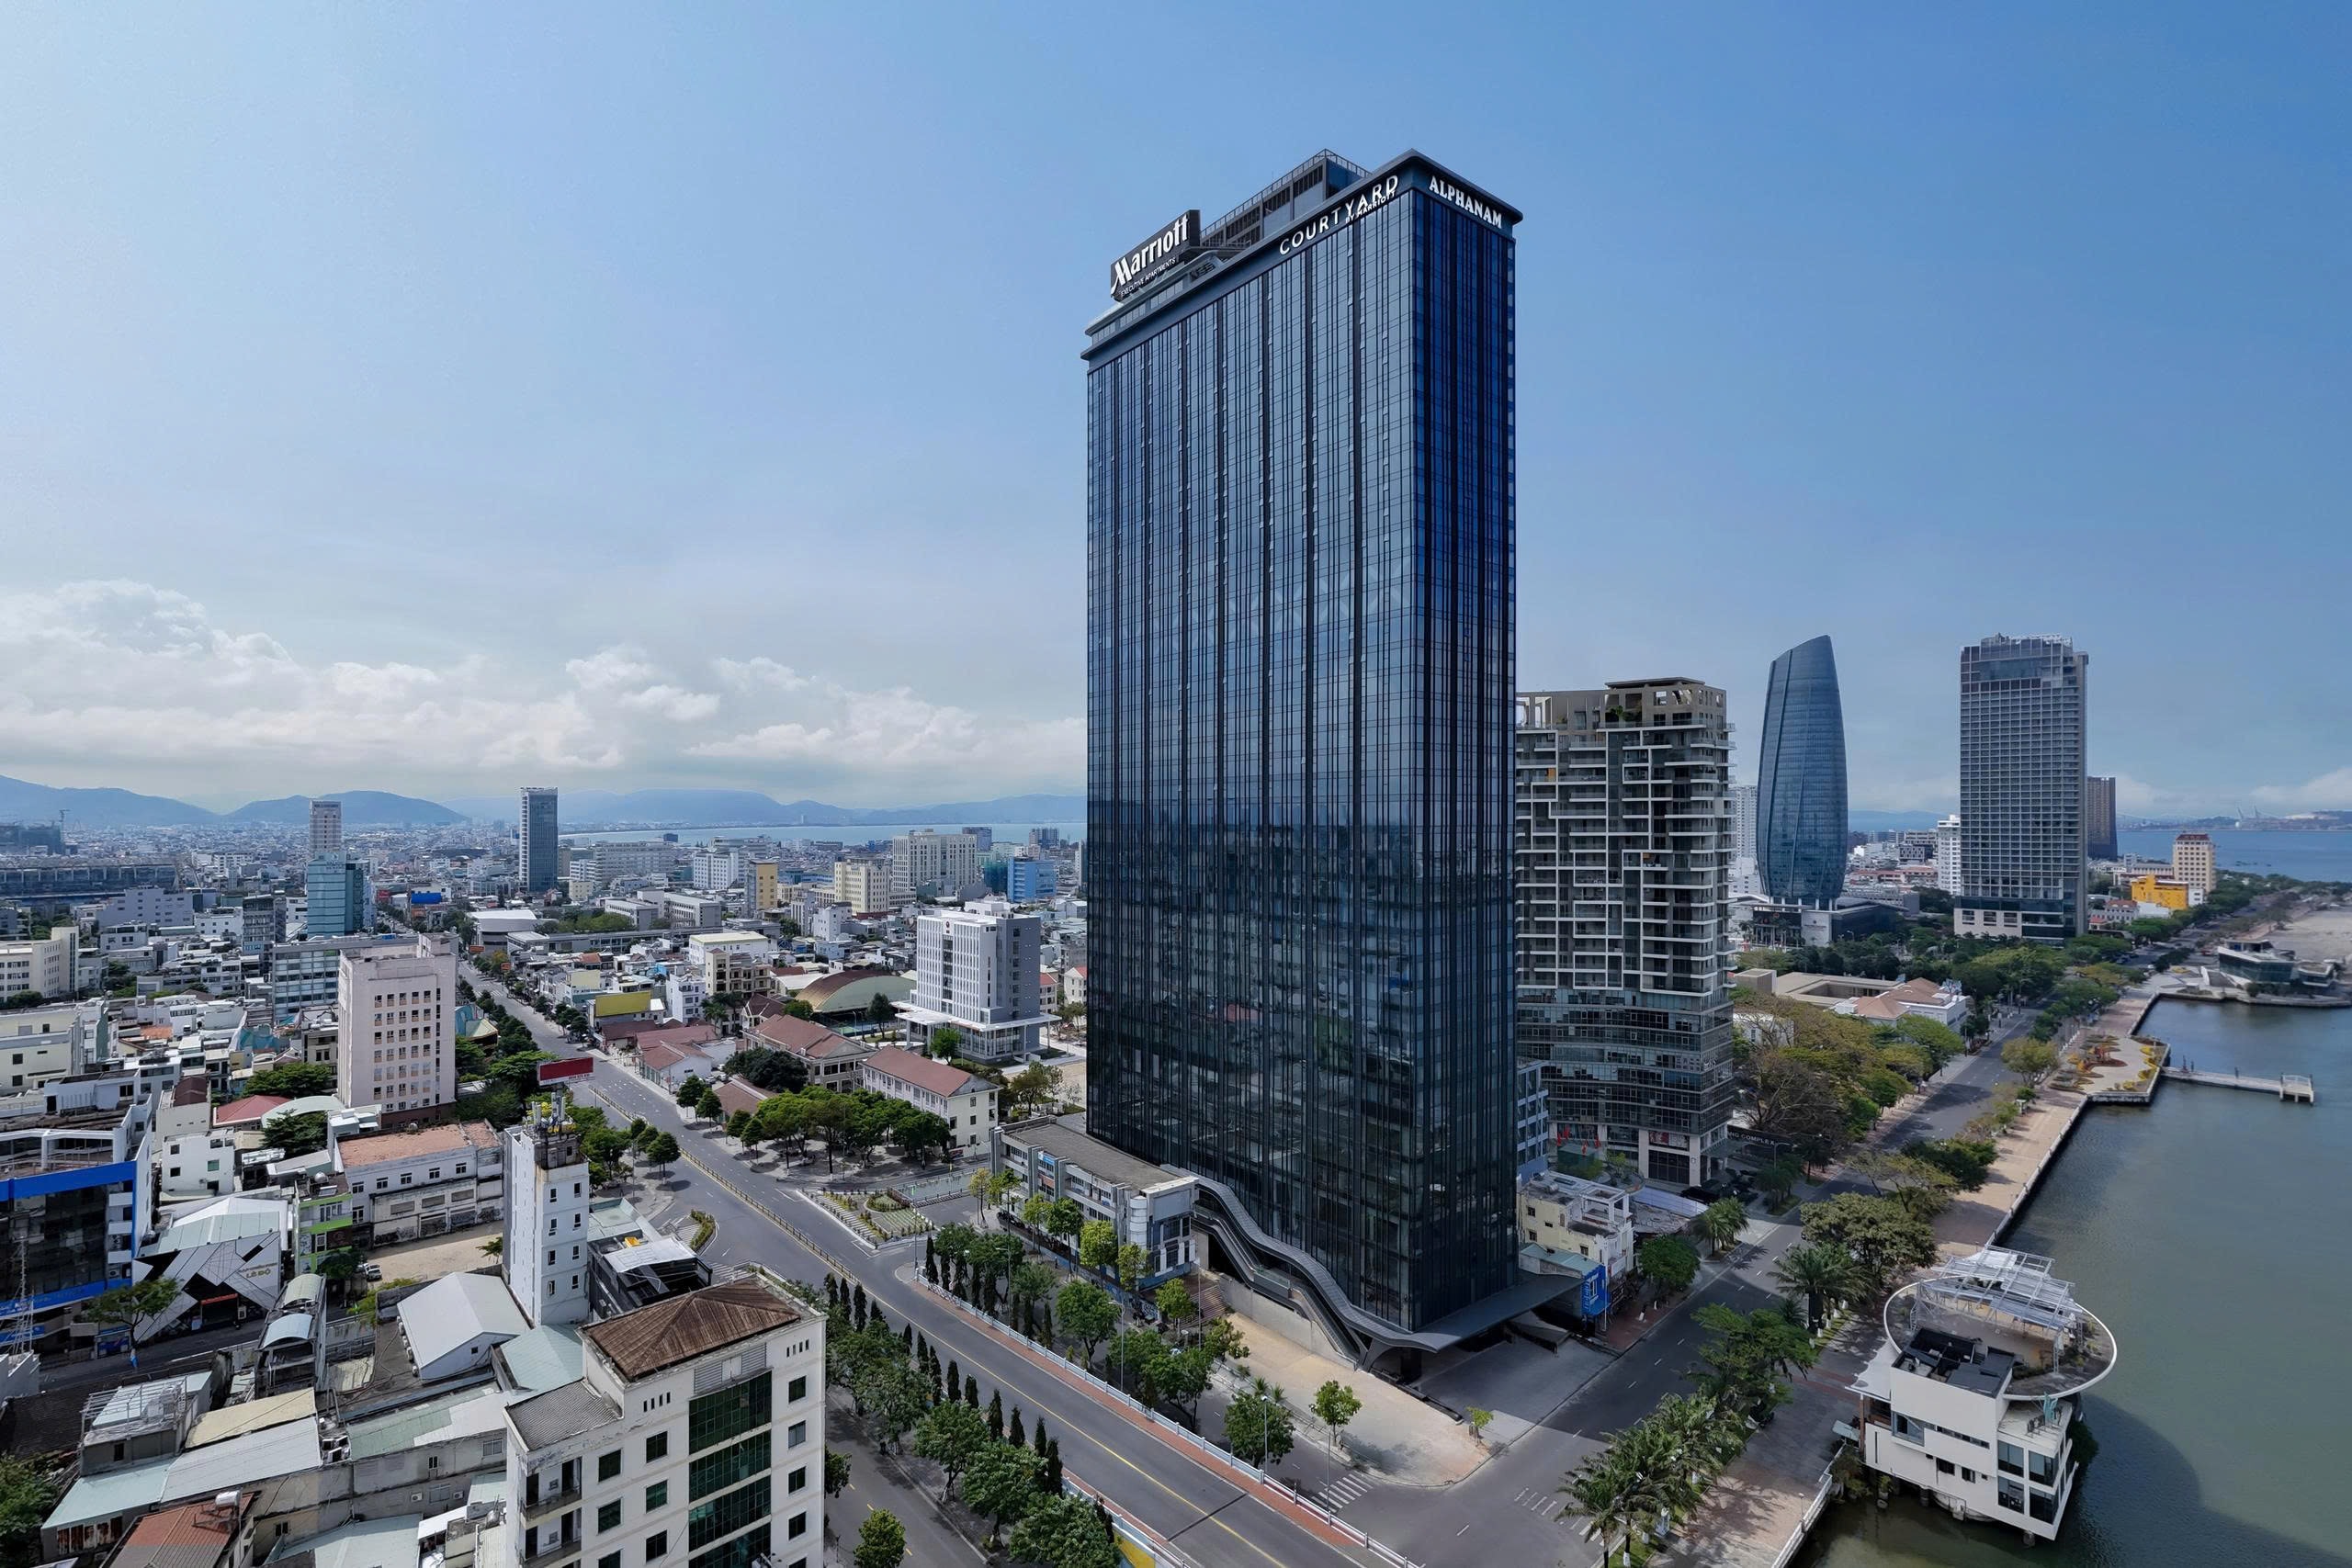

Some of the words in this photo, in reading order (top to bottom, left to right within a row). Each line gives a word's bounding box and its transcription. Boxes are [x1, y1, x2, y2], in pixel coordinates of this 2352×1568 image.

[1280, 175, 1398, 255] COURTYARD
[1346, 213, 1354, 223] BY
[1356, 190, 1396, 219] MARRIOTT
[1429, 175, 1502, 229] ALPHANAM
[1111, 214, 1189, 295] Marriott
[1121, 277, 1145, 297] EXECUTIVE
[1145, 257, 1176, 282] APARTMENTS
